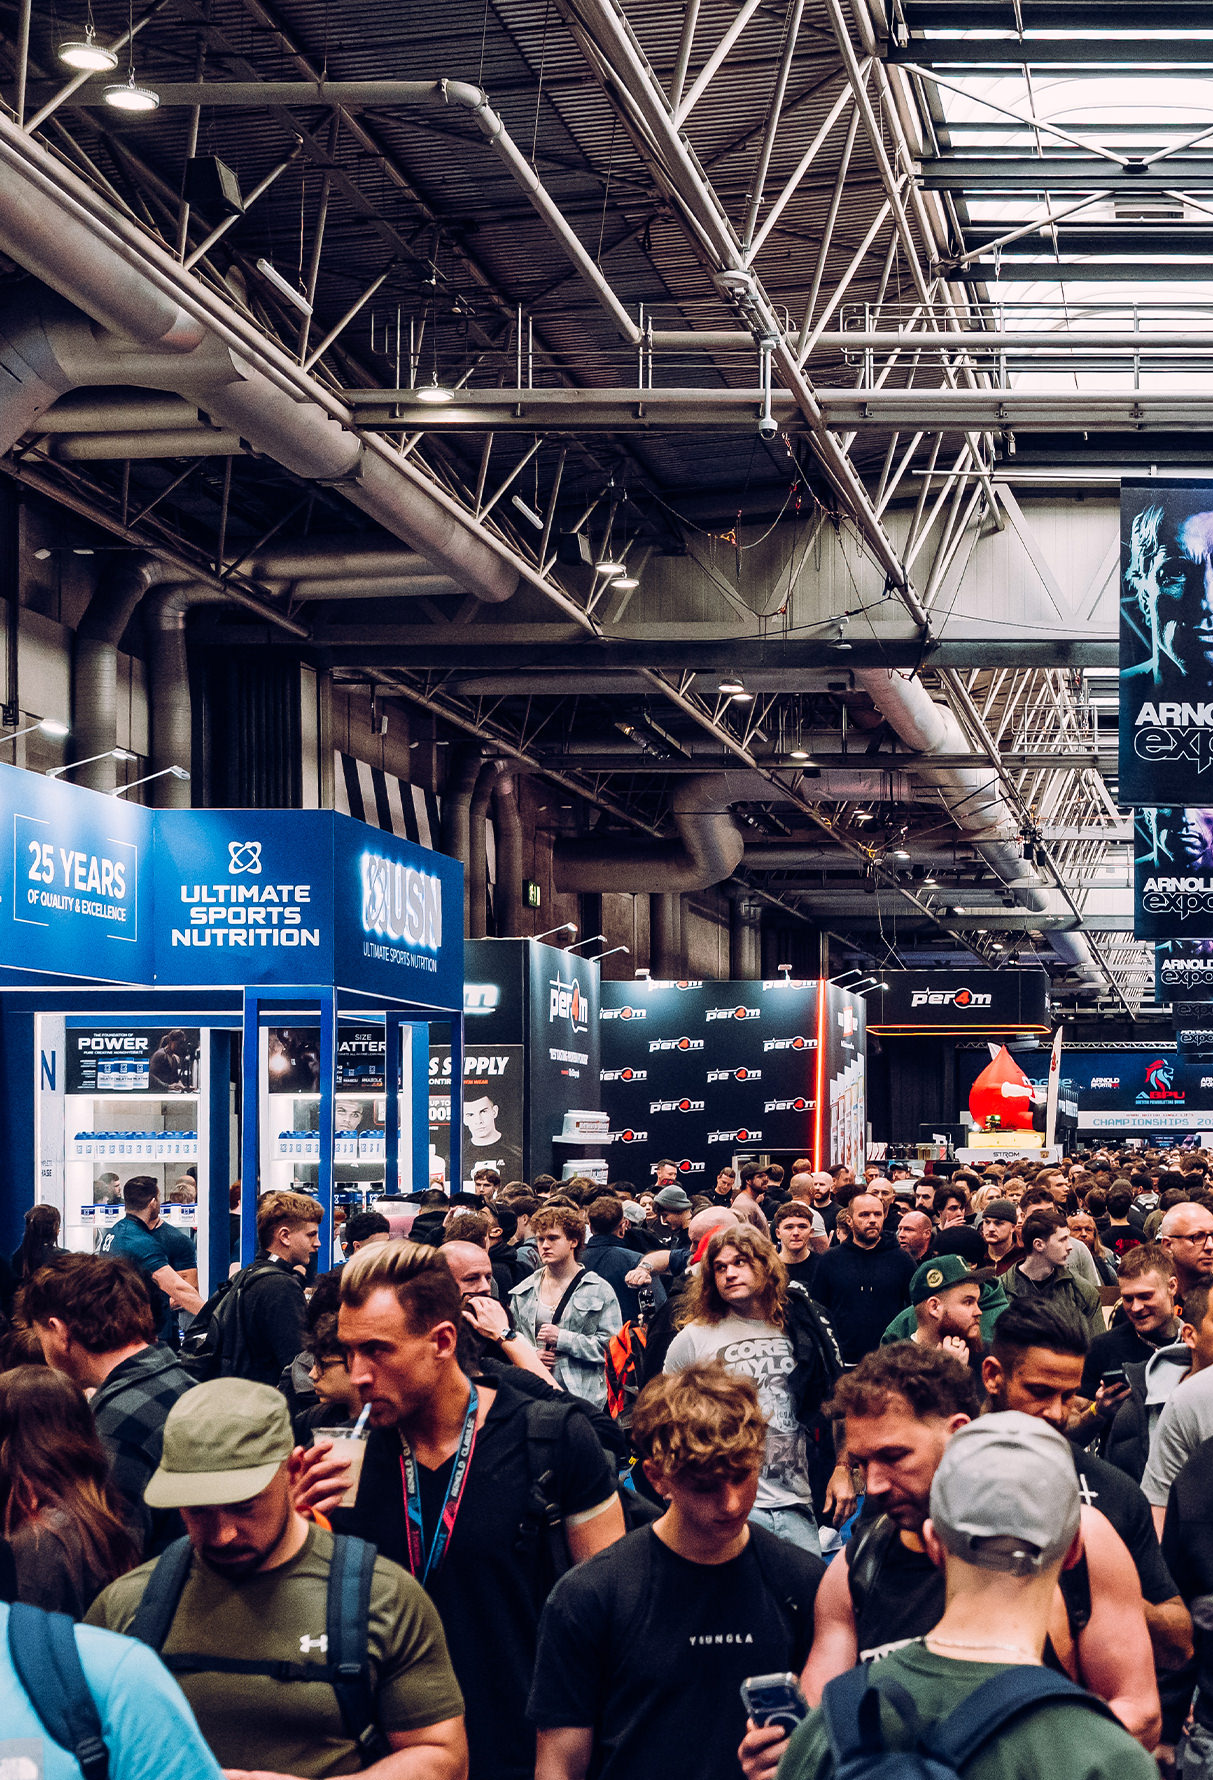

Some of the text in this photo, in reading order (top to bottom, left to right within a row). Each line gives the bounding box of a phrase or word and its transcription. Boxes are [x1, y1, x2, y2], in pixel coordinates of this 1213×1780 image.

[28, 840, 126, 899] 25 YEARS
[180, 885, 311, 903] ULTIMATE
[27, 888, 127, 922] OF QUALITY & EXCELLENCE
[387, 859, 442, 949] USN
[190, 907, 302, 925] SPORTS
[171, 928, 320, 947] NUTRITION
[363, 941, 437, 973] ULTIMATE SPORTS NUTRITION
[548, 969, 588, 1034] per4m
[911, 987, 992, 1009] per4m
[600, 1006, 647, 1021] er4m
[705, 1006, 761, 1022] per4m
[78, 1037, 149, 1050] POWER
[649, 1036, 704, 1052] per4m
[763, 1035, 818, 1052] per4m
[442, 1056, 510, 1075] SPPLY
[600, 1067, 648, 1083] er4m
[650, 1097, 705, 1114] per4m
[1093, 1118, 1189, 1126] CHAMPIONSHIPS
[708, 1127, 762, 1144] per4m
